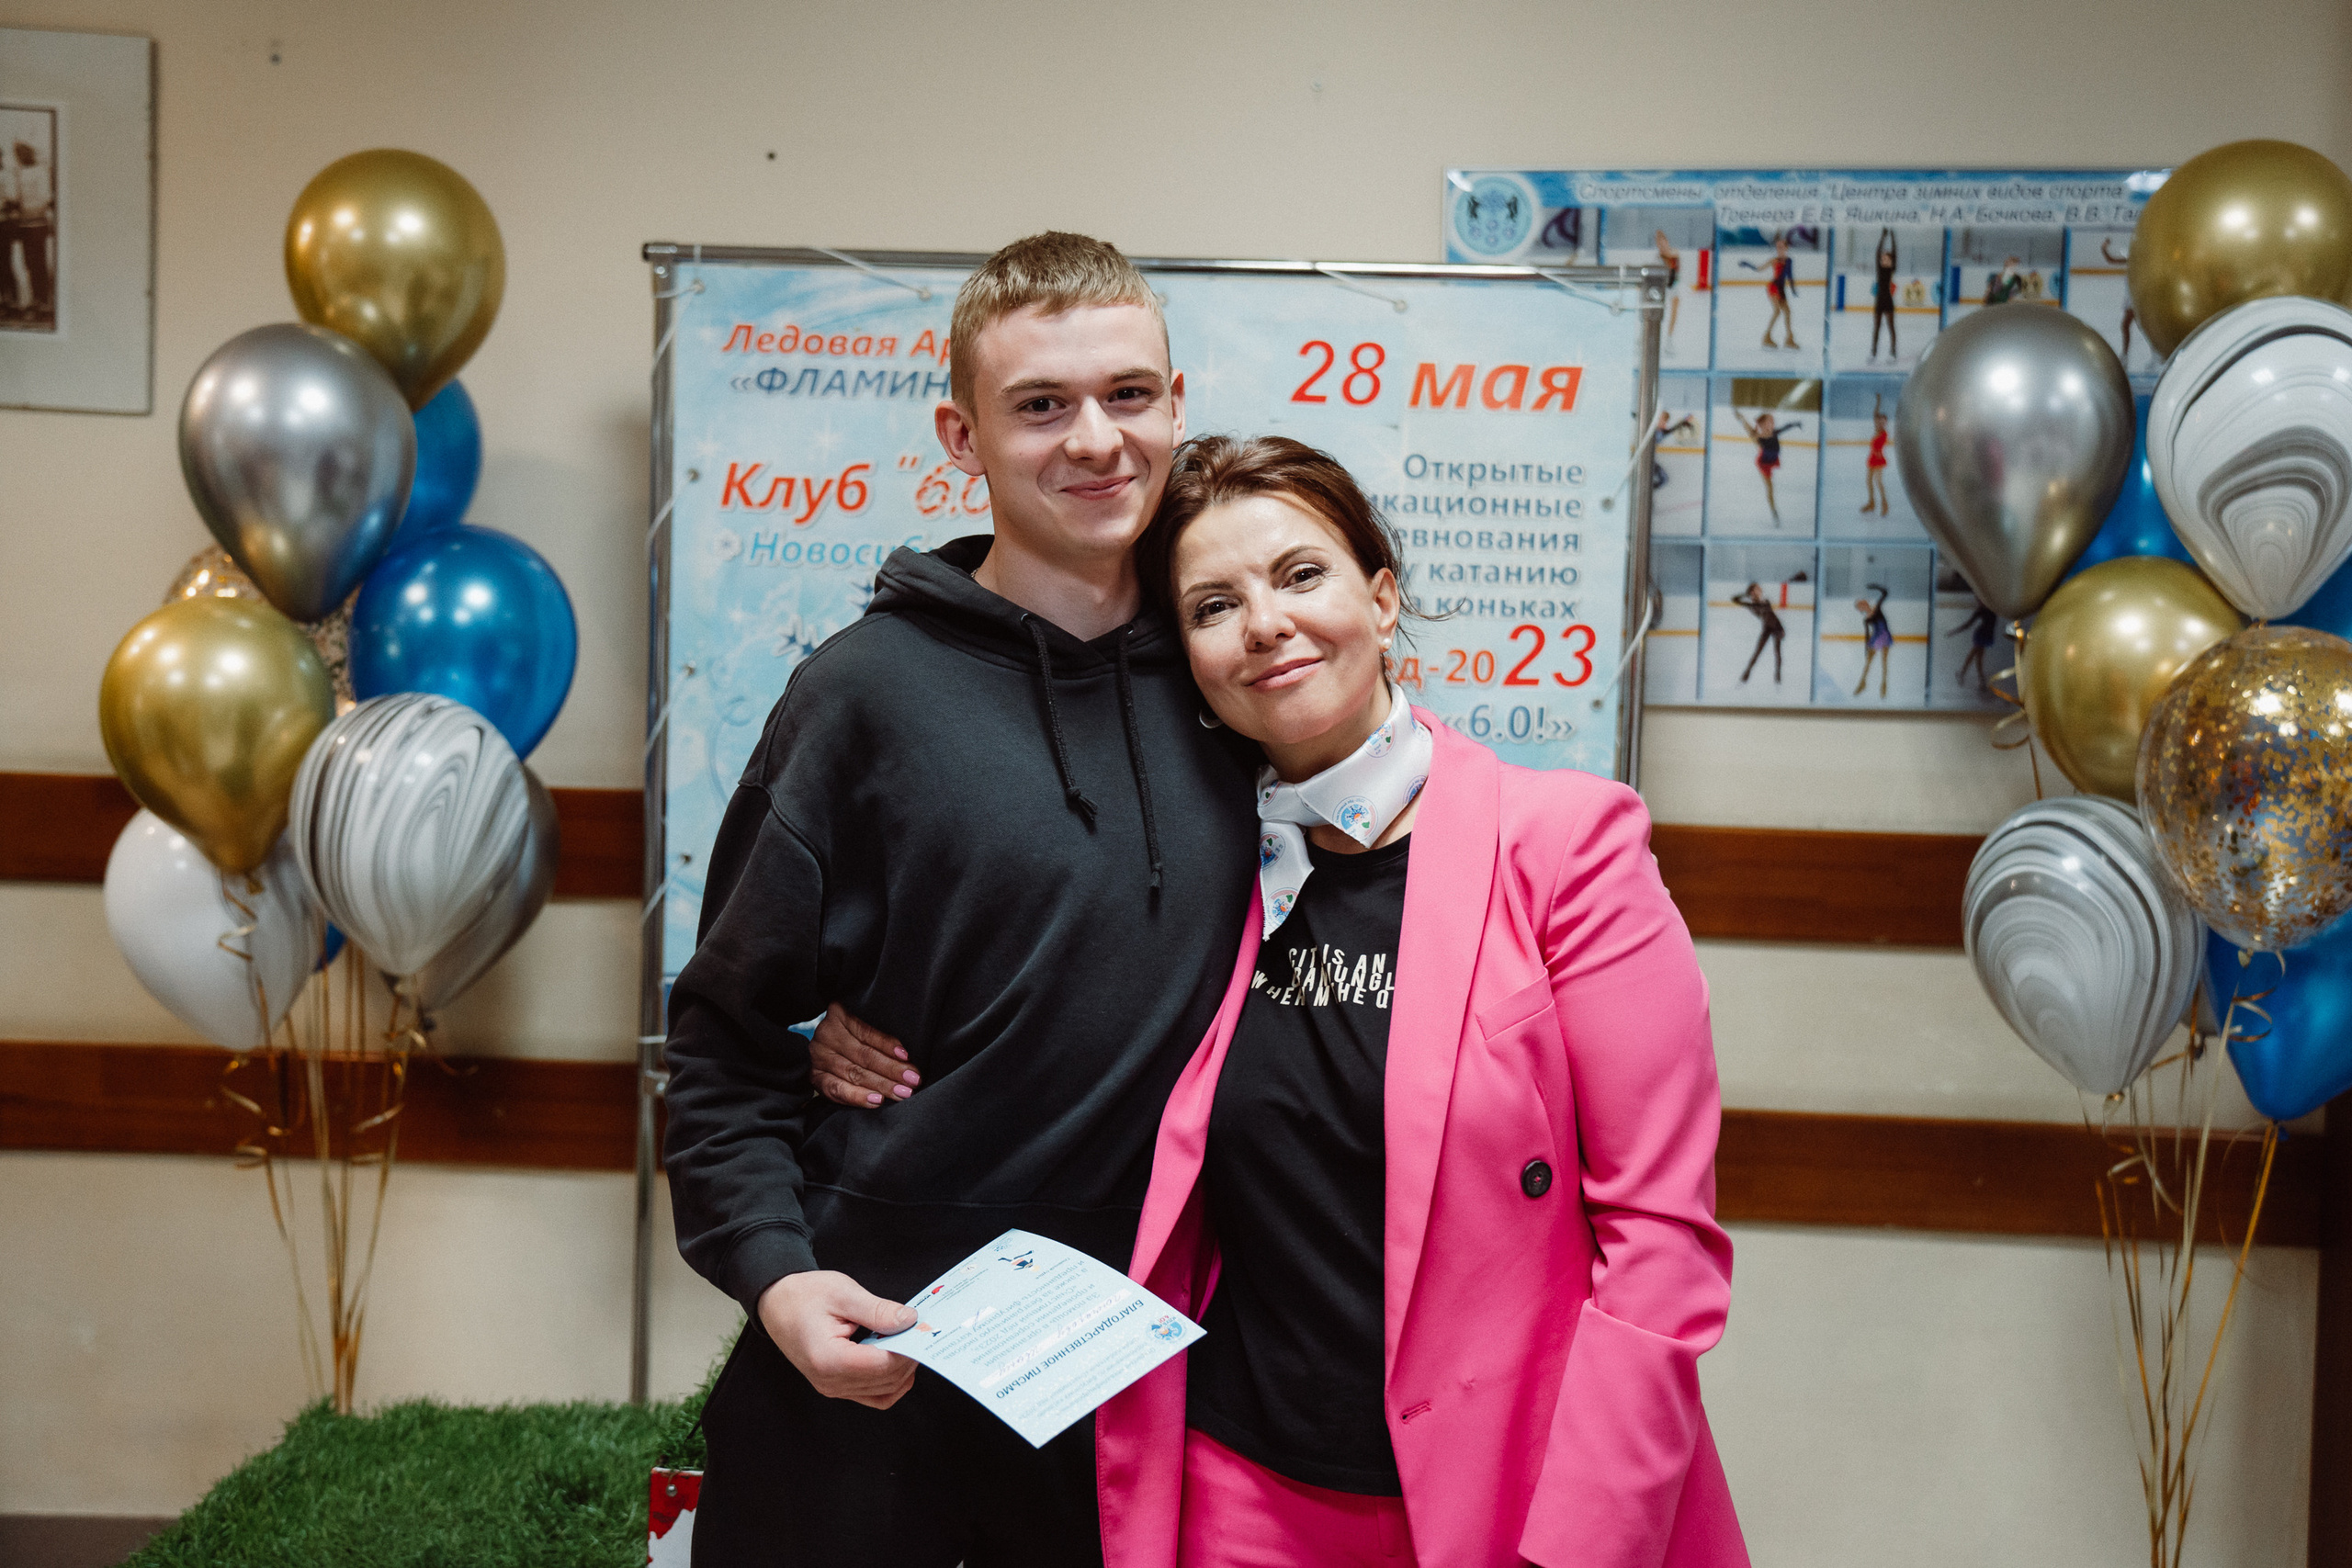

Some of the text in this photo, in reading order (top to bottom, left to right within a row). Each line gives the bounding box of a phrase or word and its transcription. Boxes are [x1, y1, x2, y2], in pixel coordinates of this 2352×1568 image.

[1986, 182, 2043, 200] видов
[722, 324, 898, 360] Ледовая
[1291, 339, 1583, 412] 28 мая
[1403, 454, 1584, 491] Открытые
[720, 461, 871, 525] Клуб
[1429, 562, 1578, 586] катанию
[1436, 596, 1577, 620] коньках
[1443, 704, 1574, 739] «6.0!»
[1019, 1262, 1079, 1303] преданность
[1052, 1270, 1081, 1292] также
[1084, 1291, 1101, 1303] За
[1034, 1287, 1089, 1324] проведении
[1047, 1299, 1087, 1325] помощь
[982, 1326, 1043, 1367] организации
[1038, 1298, 1145, 1369] БЛАГОДАРСТВЕННОЕ
[993, 1366, 1042, 1399] ПИСЬМО
